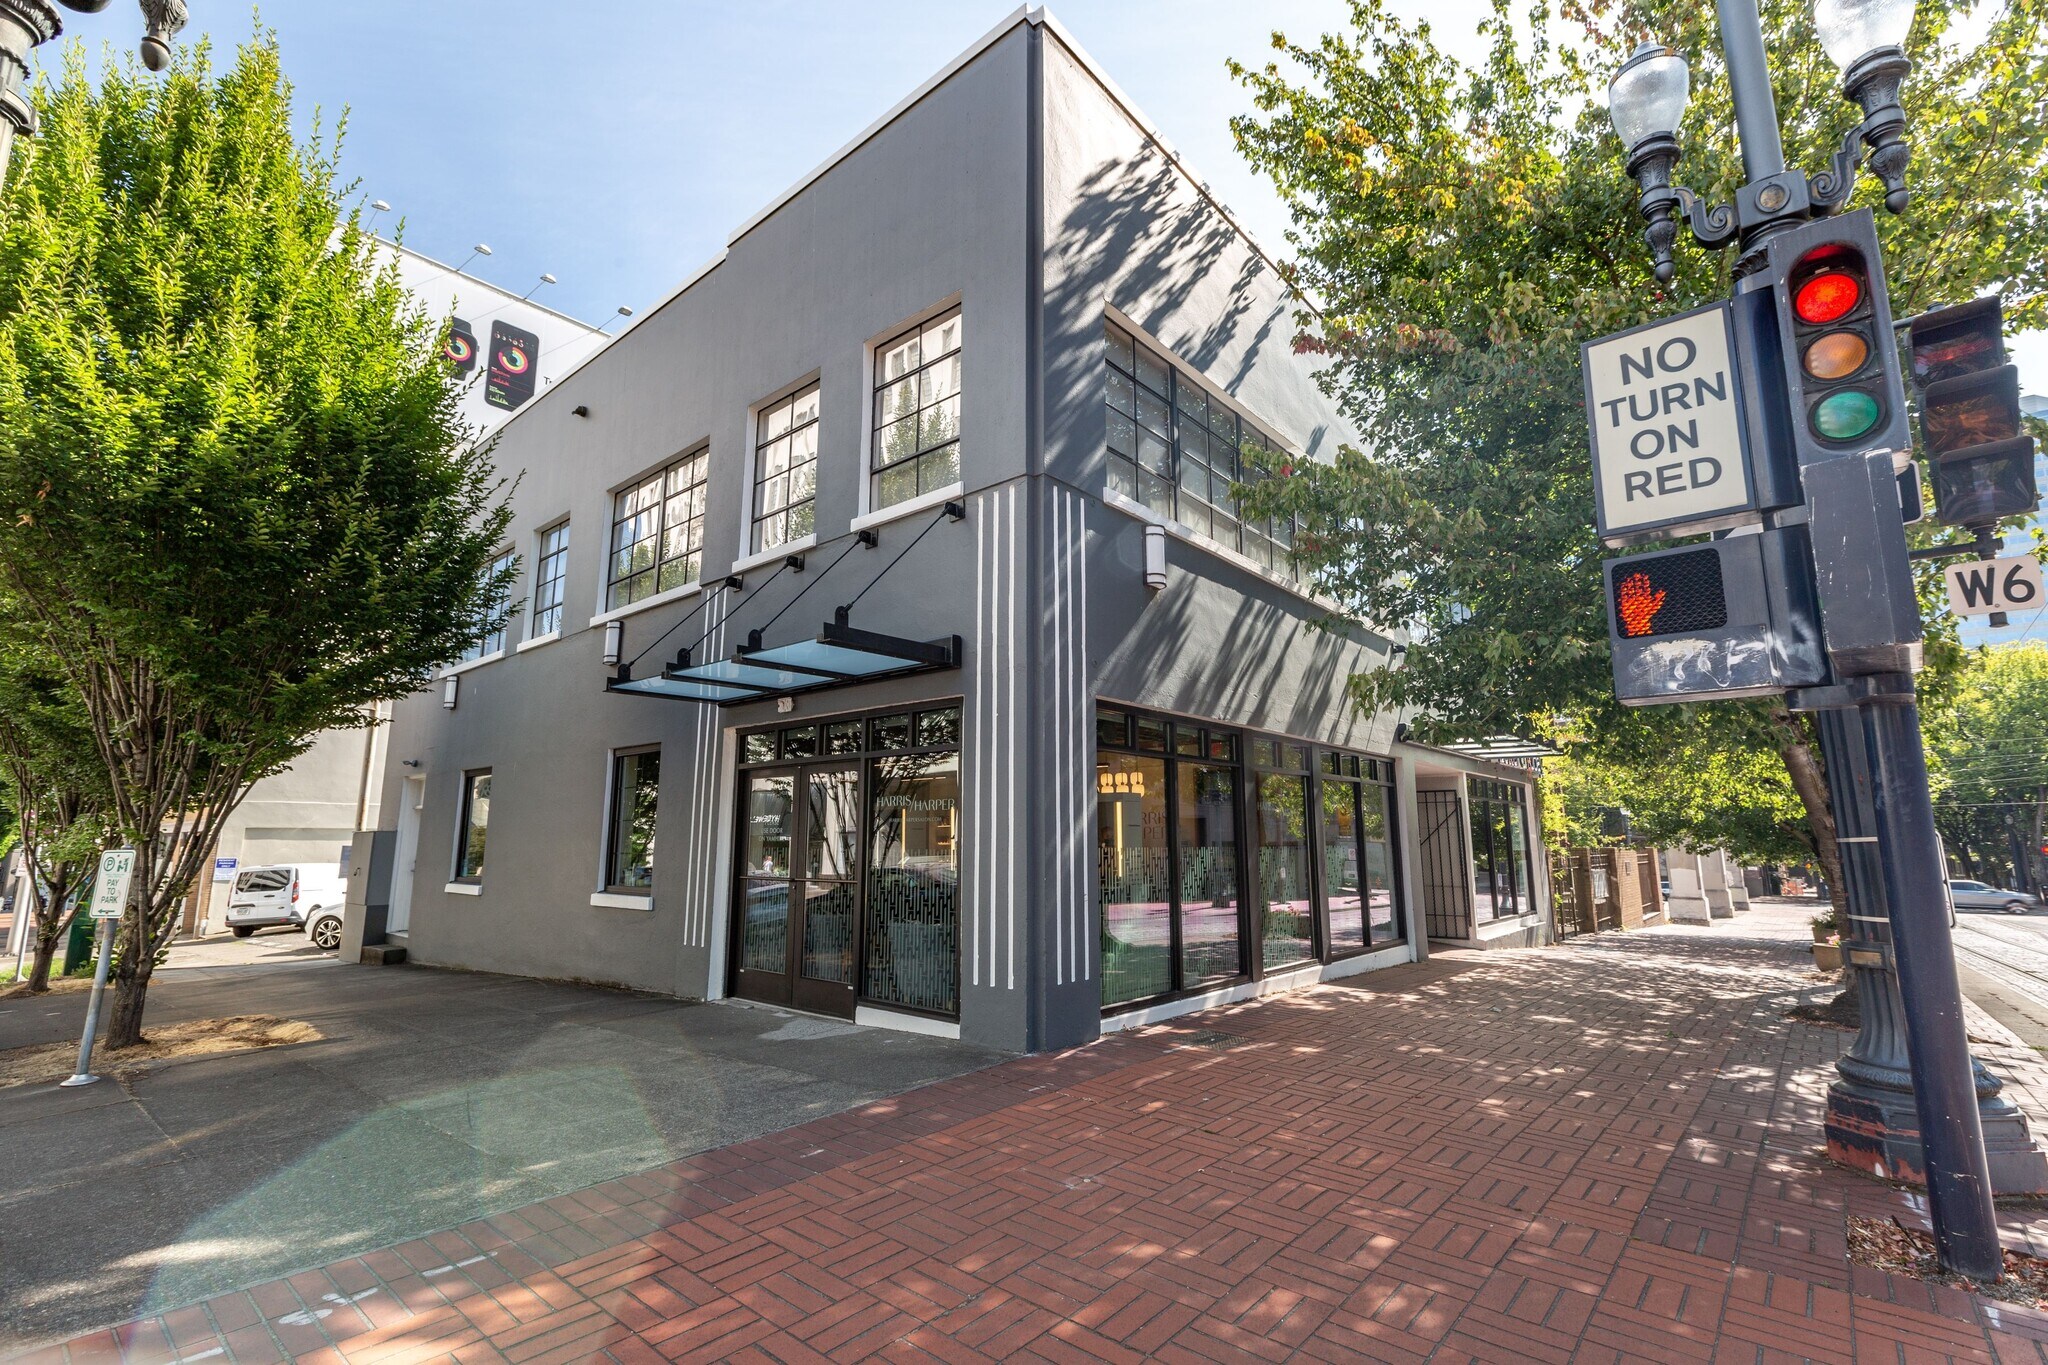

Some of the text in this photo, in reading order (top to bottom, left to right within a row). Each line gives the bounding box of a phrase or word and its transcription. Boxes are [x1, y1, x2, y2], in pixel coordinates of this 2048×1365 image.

[1619, 336, 1697, 386] NO
[1600, 371, 1727, 428] TURN
[1630, 419, 1699, 460] ON
[1624, 456, 1723, 502] RED
[1955, 564, 2036, 608] W6
[101, 896, 118, 904] PARK
[106, 879, 119, 887] PAY
